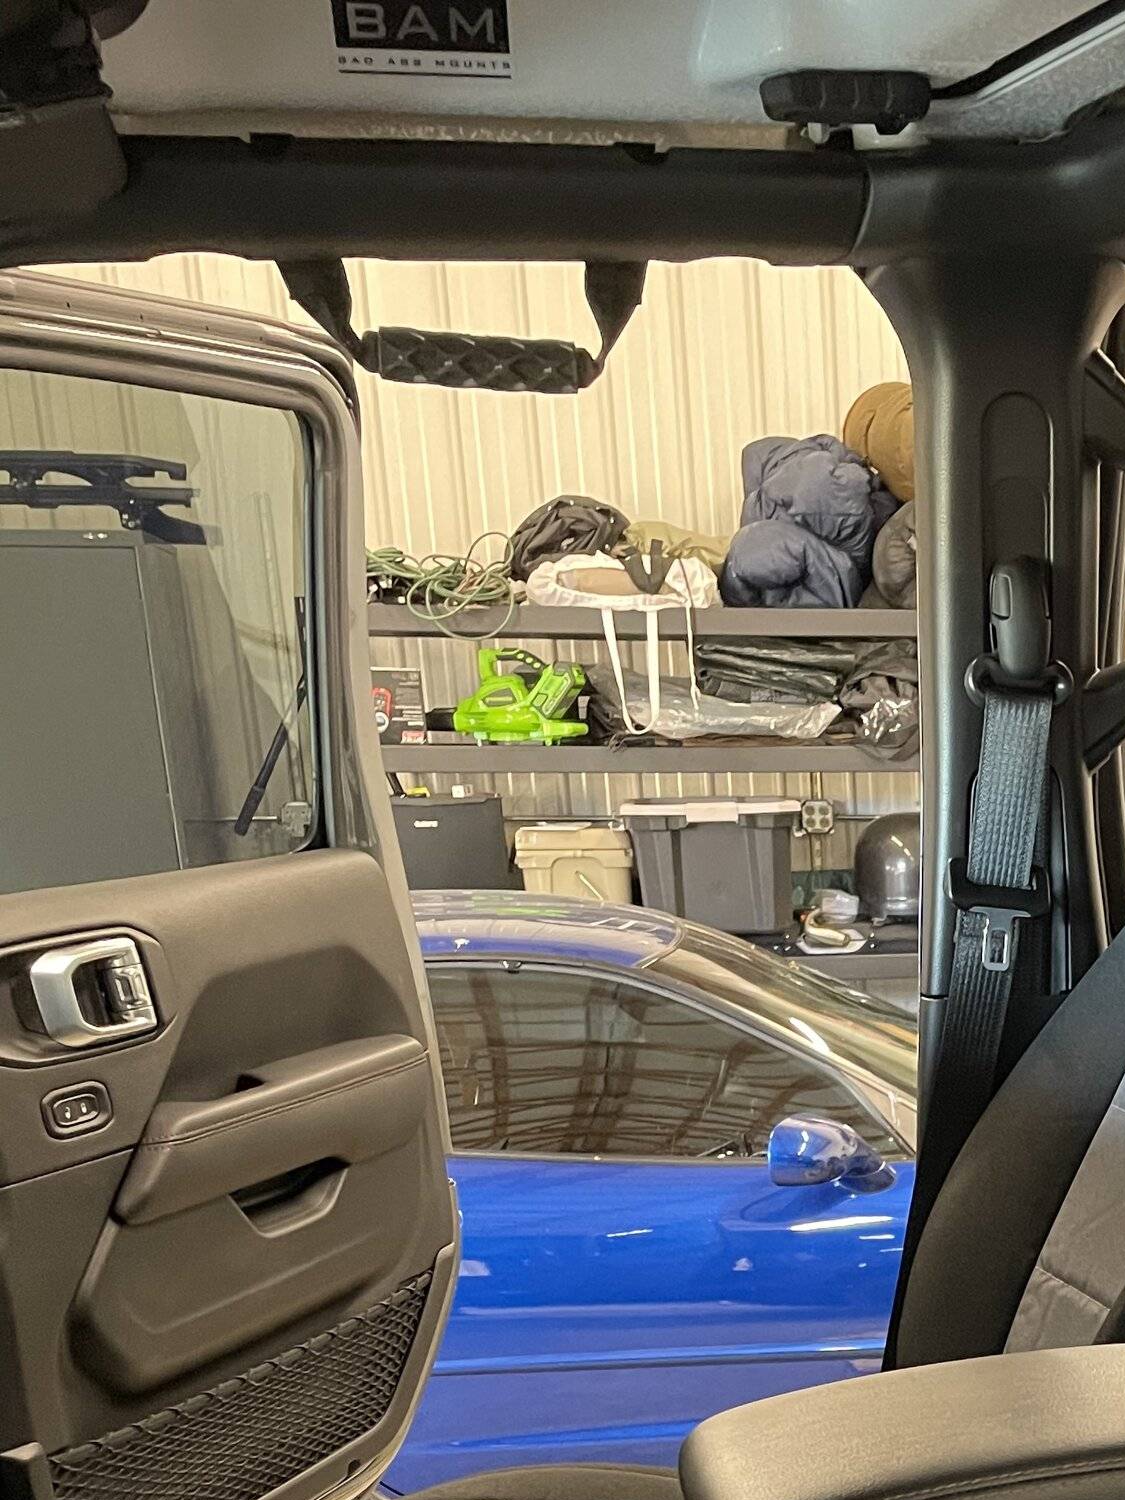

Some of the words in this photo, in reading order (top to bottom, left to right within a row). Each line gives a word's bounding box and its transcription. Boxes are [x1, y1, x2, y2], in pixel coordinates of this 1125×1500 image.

[346, 1, 496, 44] BAM
[338, 56, 373, 66] BAD
[388, 57, 421, 67] ASS
[435, 59, 510, 69] MOUNTS
